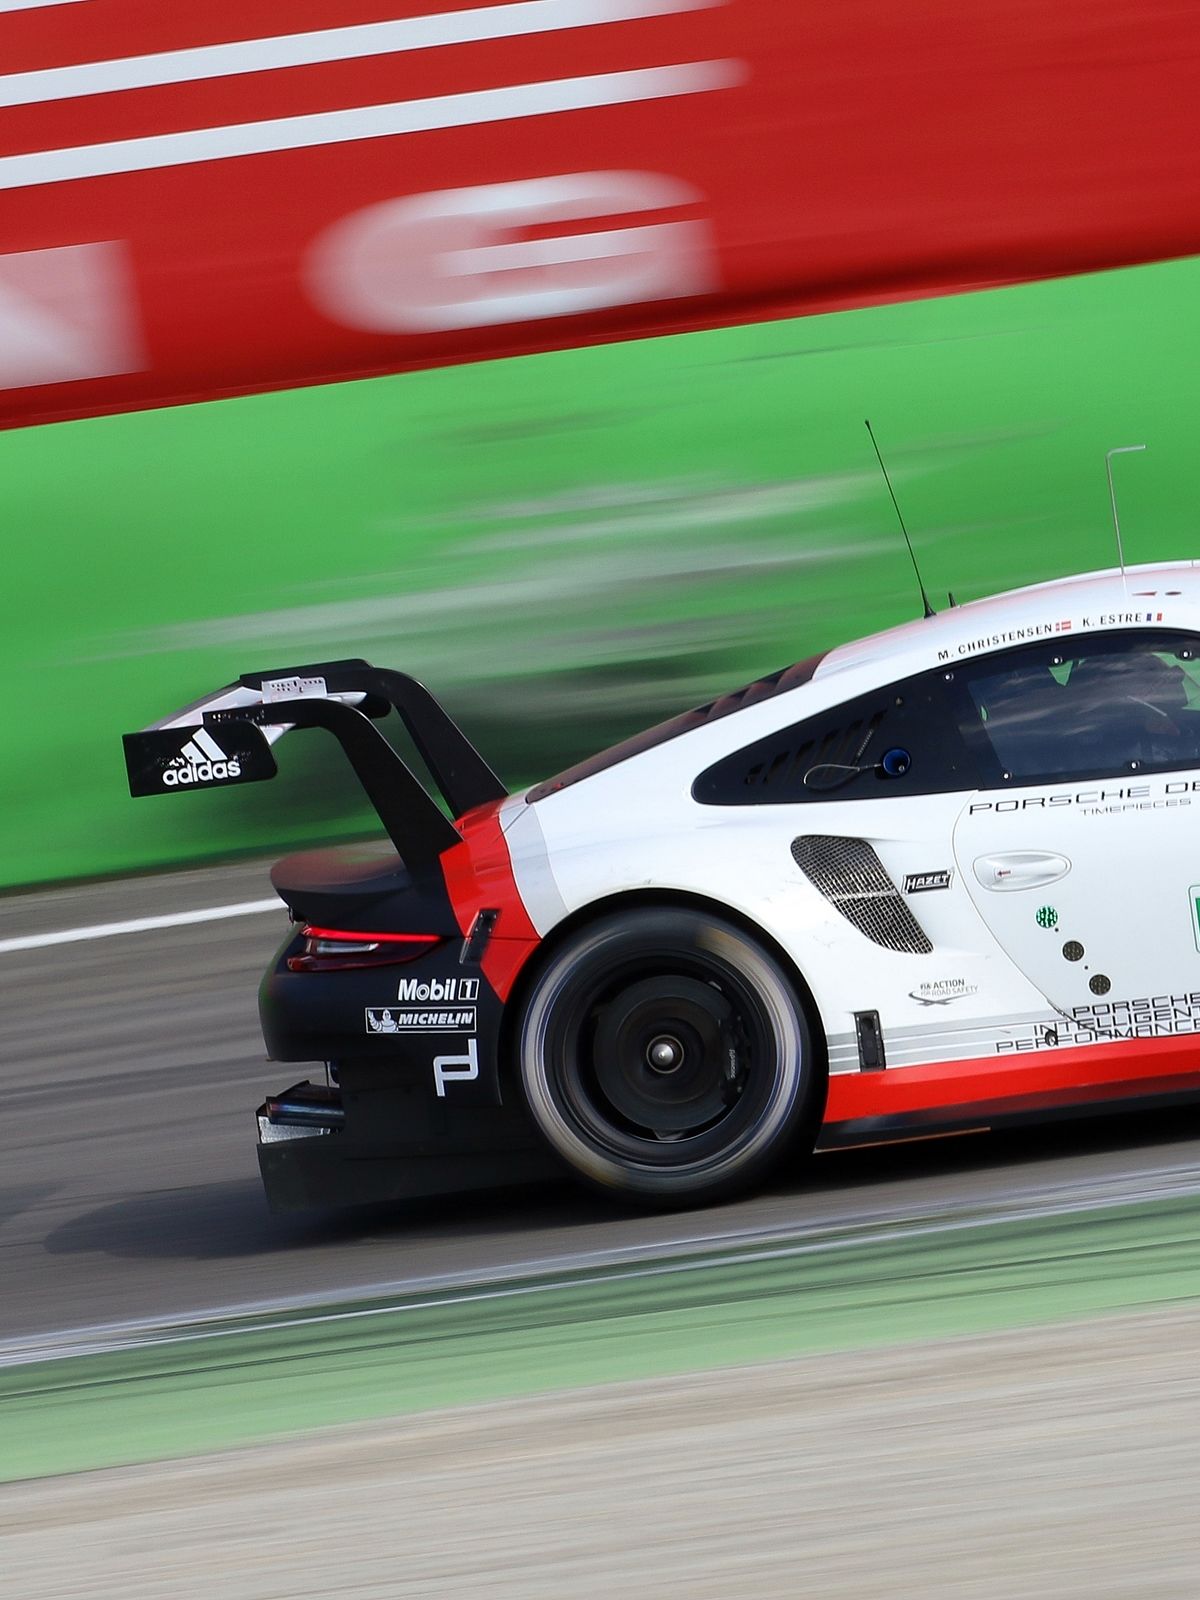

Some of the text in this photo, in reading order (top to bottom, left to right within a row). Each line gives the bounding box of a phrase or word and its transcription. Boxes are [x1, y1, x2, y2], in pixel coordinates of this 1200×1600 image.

[1082, 612, 1142, 627] K. ESTRE
[937, 623, 1054, 661] M. CHRISTENSEN
[162, 759, 242, 786] adidas
[968, 784, 1151, 816] PORSCHE
[1078, 798, 1192, 817] TIMEPIECES
[906, 875, 949, 890] HAZET
[397, 978, 456, 1001] Mobil
[933, 978, 965, 990] ACTION
[952, 985, 978, 995] SAFETY
[398, 1011, 474, 1026] MICHELIN
